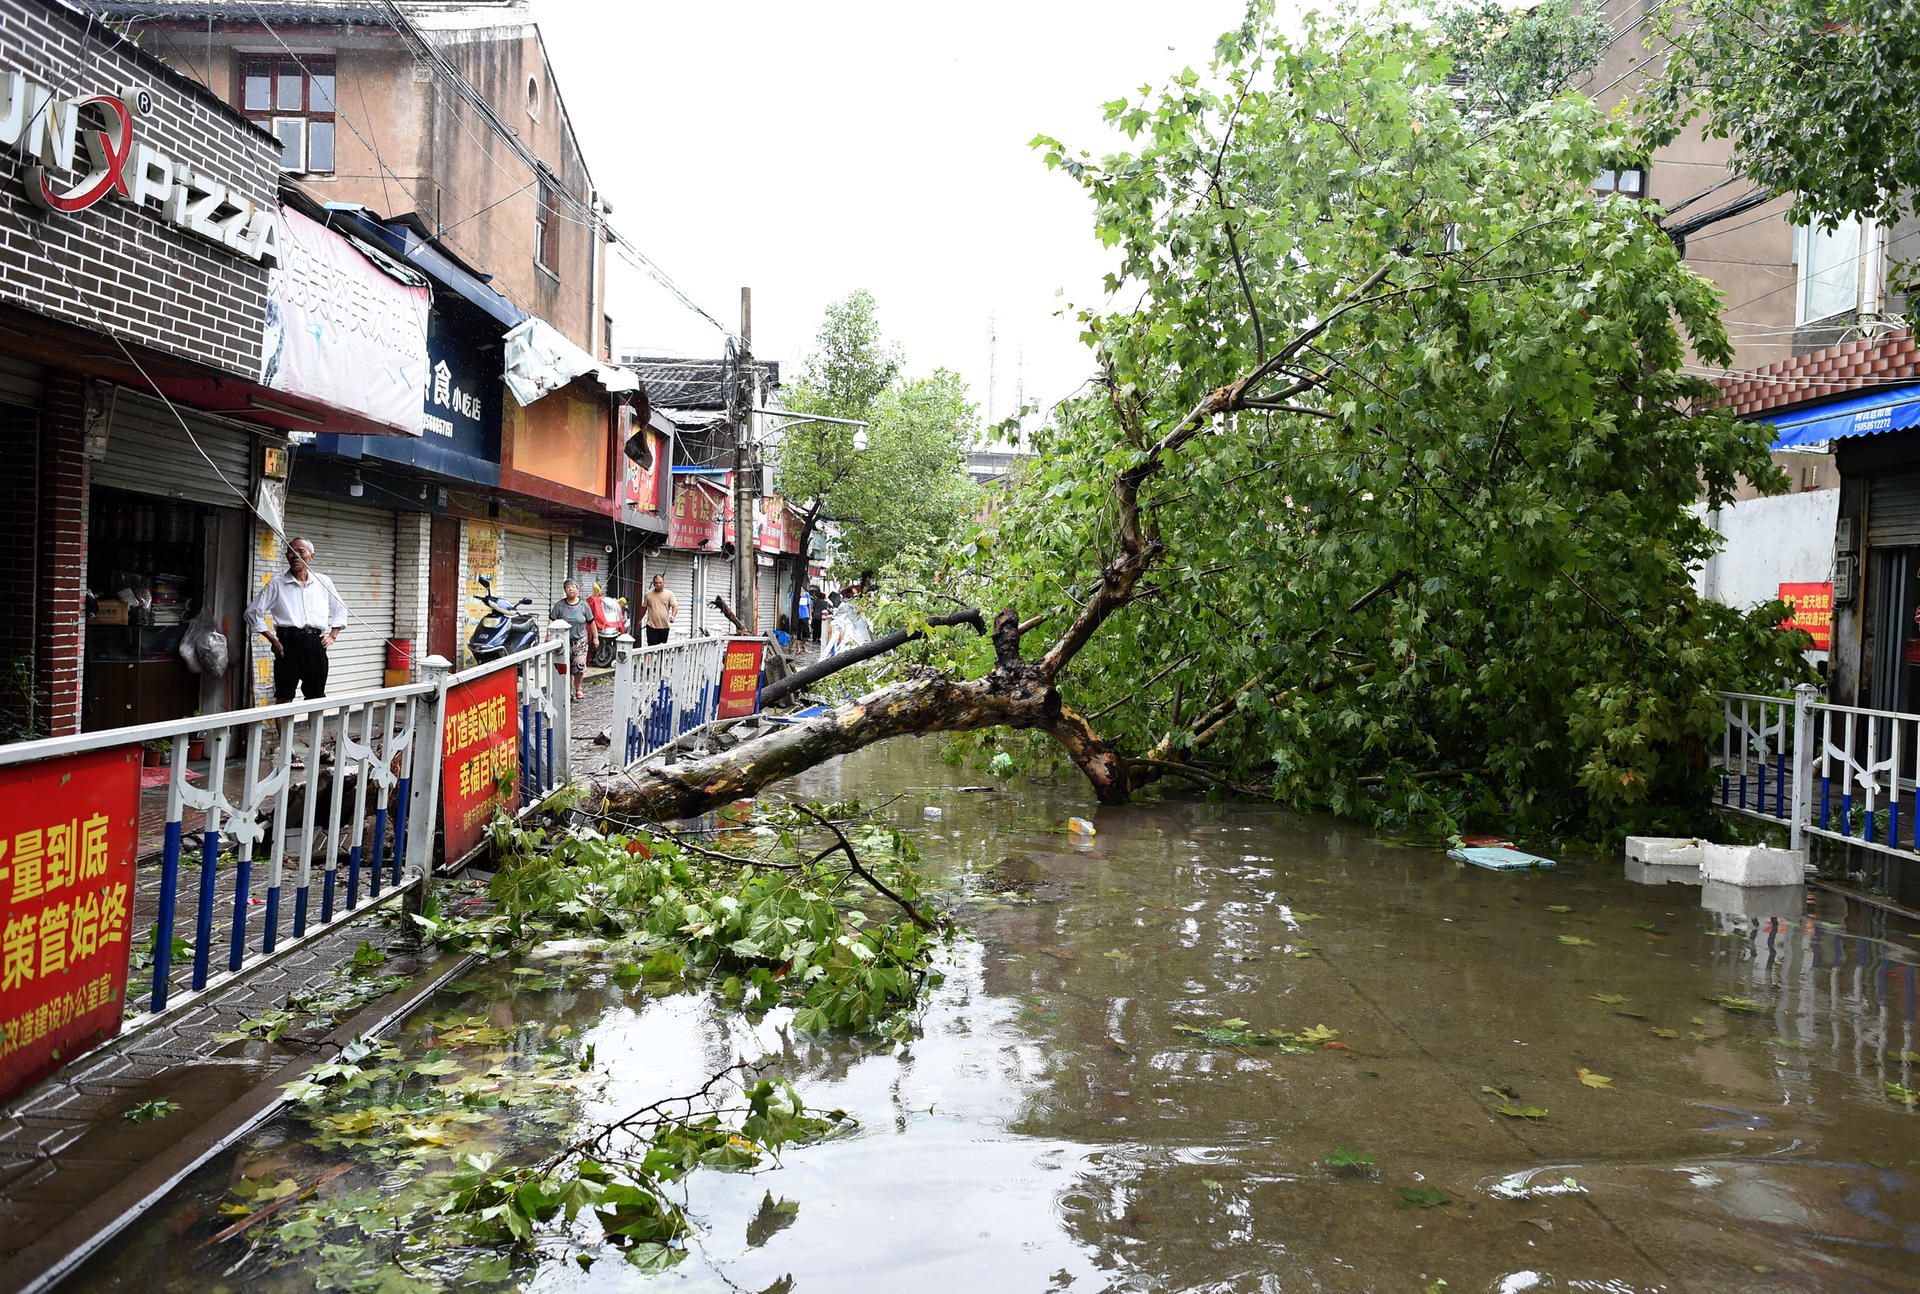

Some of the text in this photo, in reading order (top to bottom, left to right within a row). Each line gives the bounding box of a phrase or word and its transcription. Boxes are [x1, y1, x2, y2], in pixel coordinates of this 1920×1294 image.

[446, 694, 507, 756] 打造美丽城市
[459, 735, 517, 801] 幸福百姓自己
[0, 972, 112, 1058] 改造建设办公室宣
